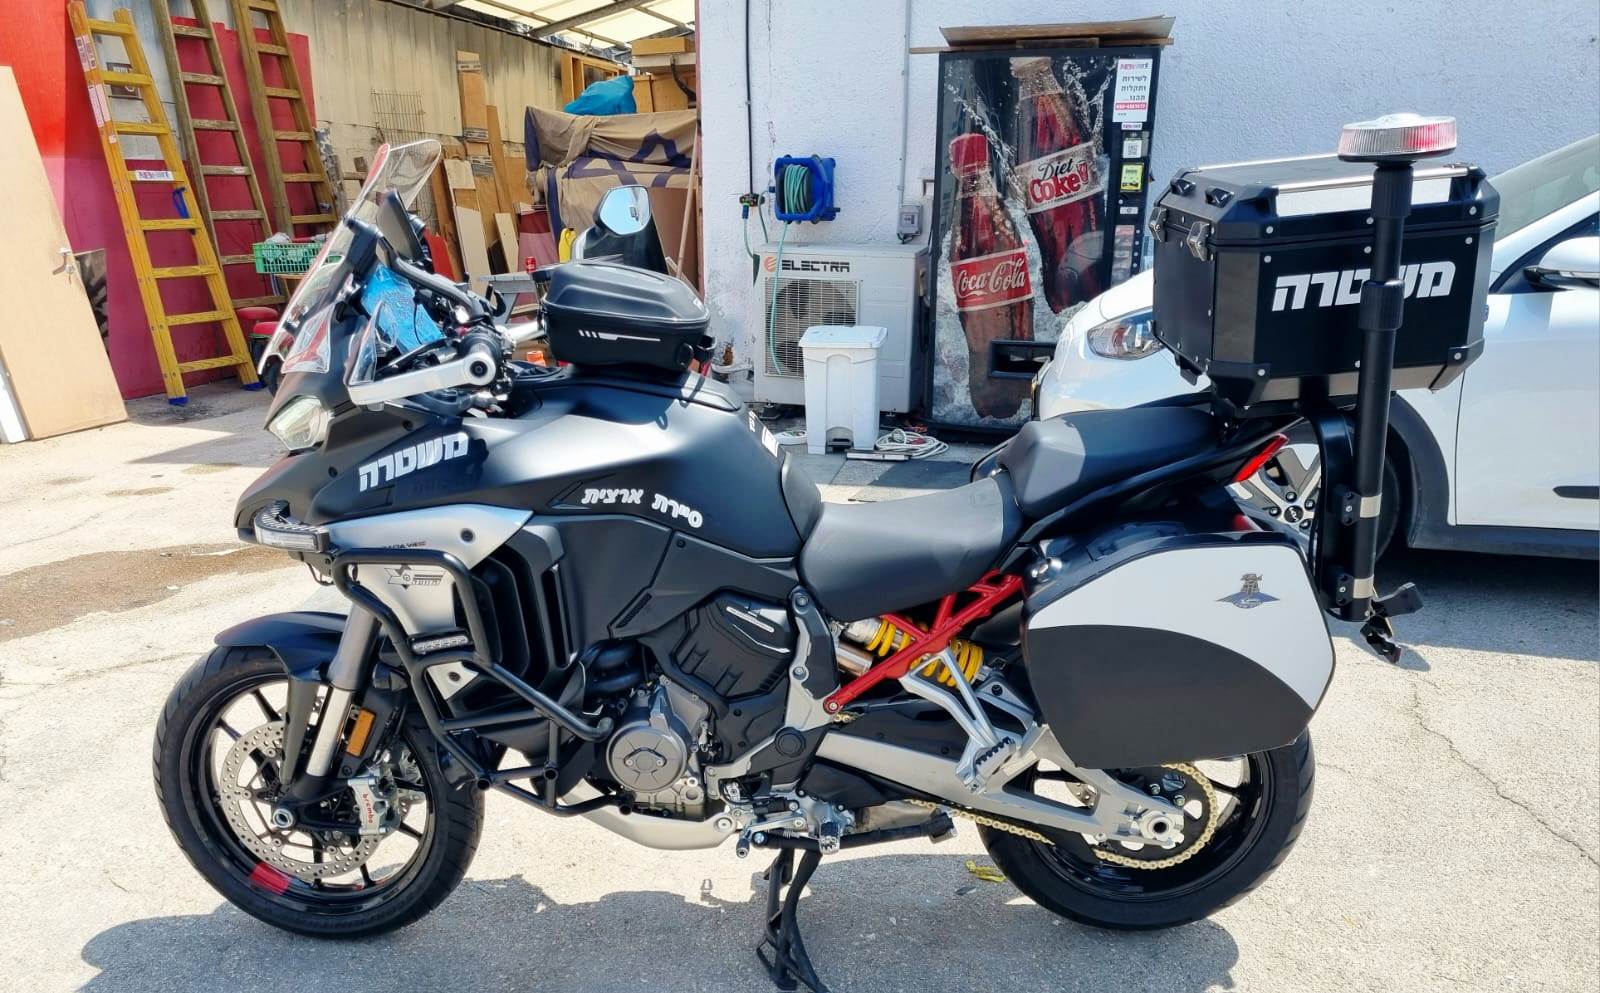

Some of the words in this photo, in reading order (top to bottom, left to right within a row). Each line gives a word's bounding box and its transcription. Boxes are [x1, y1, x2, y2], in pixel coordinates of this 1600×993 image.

[1038, 158, 1074, 180] Diet
[1029, 173, 1081, 204] Coke
[781, 259, 850, 272] ELECTRA
[359, 432, 469, 492] משטרה
[581, 488, 645, 505] ארצית
[362, 793, 374, 824] brembo
